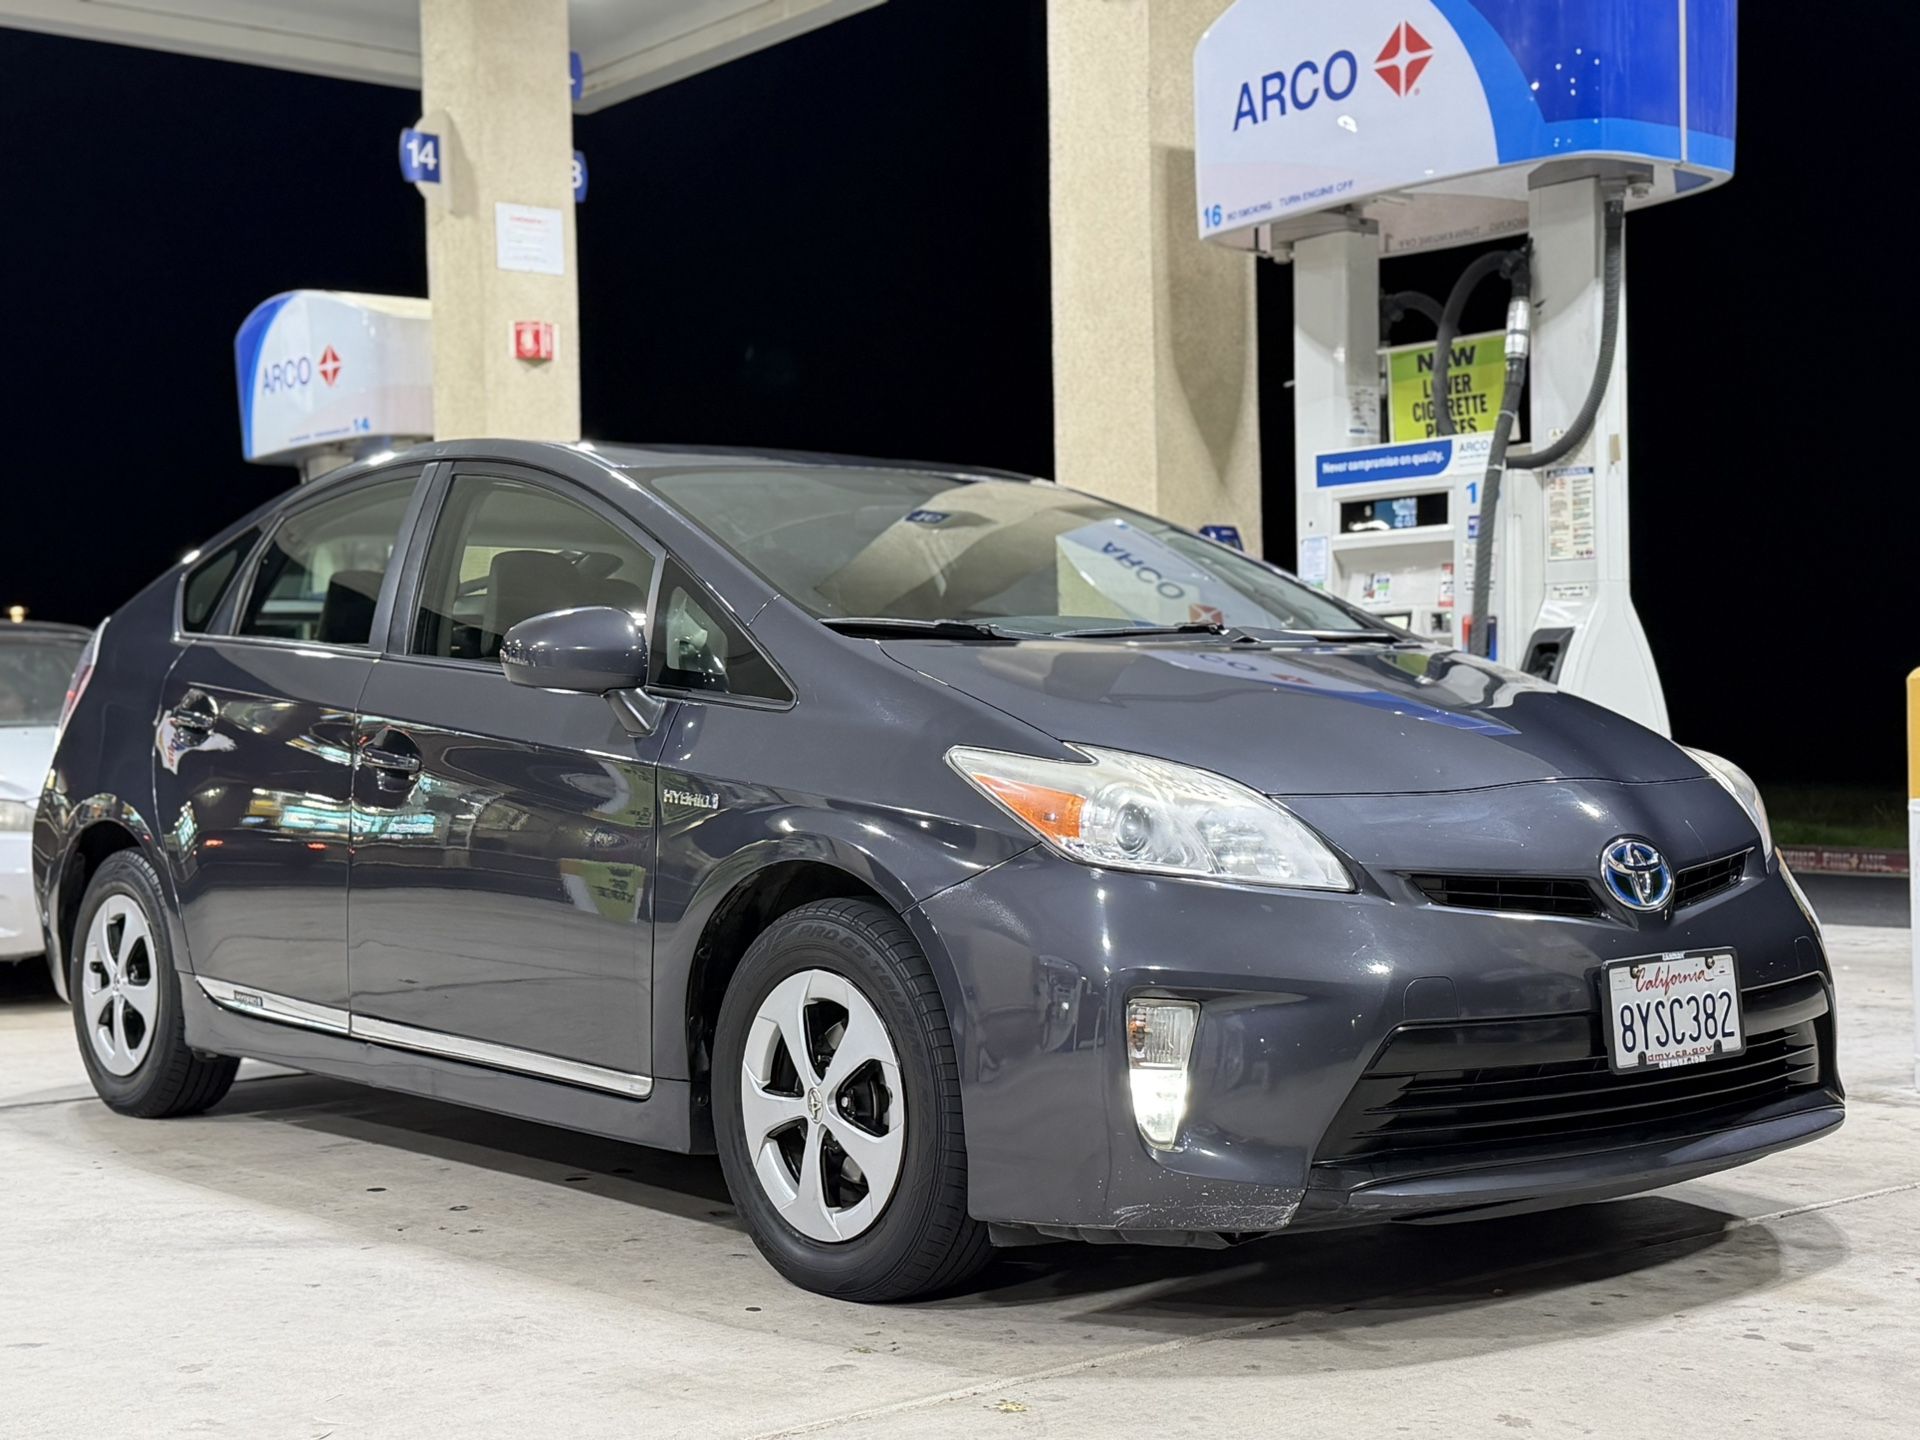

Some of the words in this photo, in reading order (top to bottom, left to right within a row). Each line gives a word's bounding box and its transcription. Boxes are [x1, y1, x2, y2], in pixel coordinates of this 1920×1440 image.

[1232, 48, 1358, 132] ARCO
[406, 138, 438, 171] 14
[1205, 204, 1223, 229] 16
[1280, 195, 1301, 209] TURN
[1302, 185, 1335, 203] ENGINE
[1336, 180, 1354, 194] OFF
[1417, 345, 1476, 373] NW
[261, 356, 311, 396] ARCO
[1412, 393, 1487, 422] CIGRETTE
[354, 416, 371, 432] 14
[1459, 439, 1489, 454] ARCO
[1321, 462, 1347, 474] Never
[1348, 455, 1399, 472] compromise
[1400, 454, 1411, 466] on
[664, 789, 710, 808] HYBRID
[798, 923, 840, 941] PRO
[839, 936, 871, 960] GS
[1634, 962, 1715, 997] California
[1620, 990, 1735, 1053] 8YSC382
[1647, 1045, 1713, 1064] dmv.ca.gov
